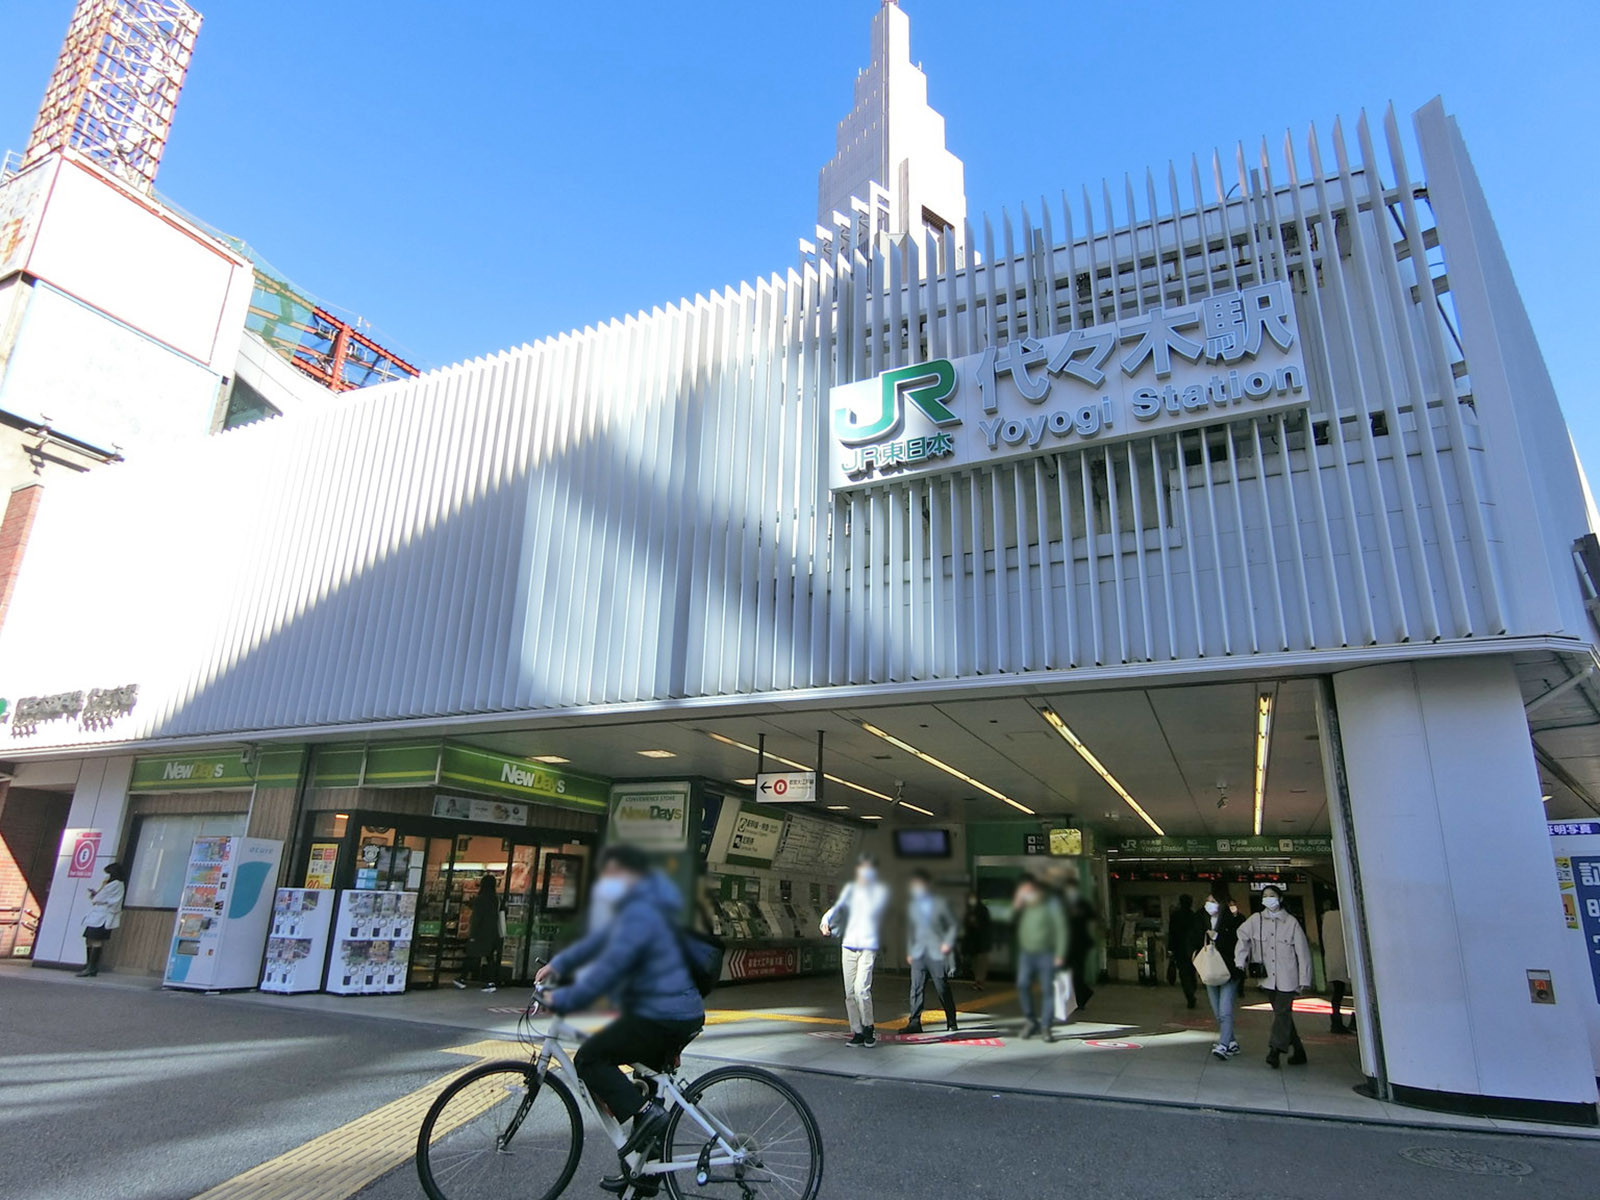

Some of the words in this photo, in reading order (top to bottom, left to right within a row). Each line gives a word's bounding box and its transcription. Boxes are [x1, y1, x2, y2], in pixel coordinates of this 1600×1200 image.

[975, 282, 1294, 414] 代々木駅
[835, 358, 962, 445] JR
[979, 396, 1113, 448] Yoyogi
[1132, 365, 1304, 420] Station
[841, 431, 953, 473] JR東日本
[163, 761, 225, 780] NewDays
[500, 763, 566, 794] NewDays
[620, 805, 682, 821] NewDays
